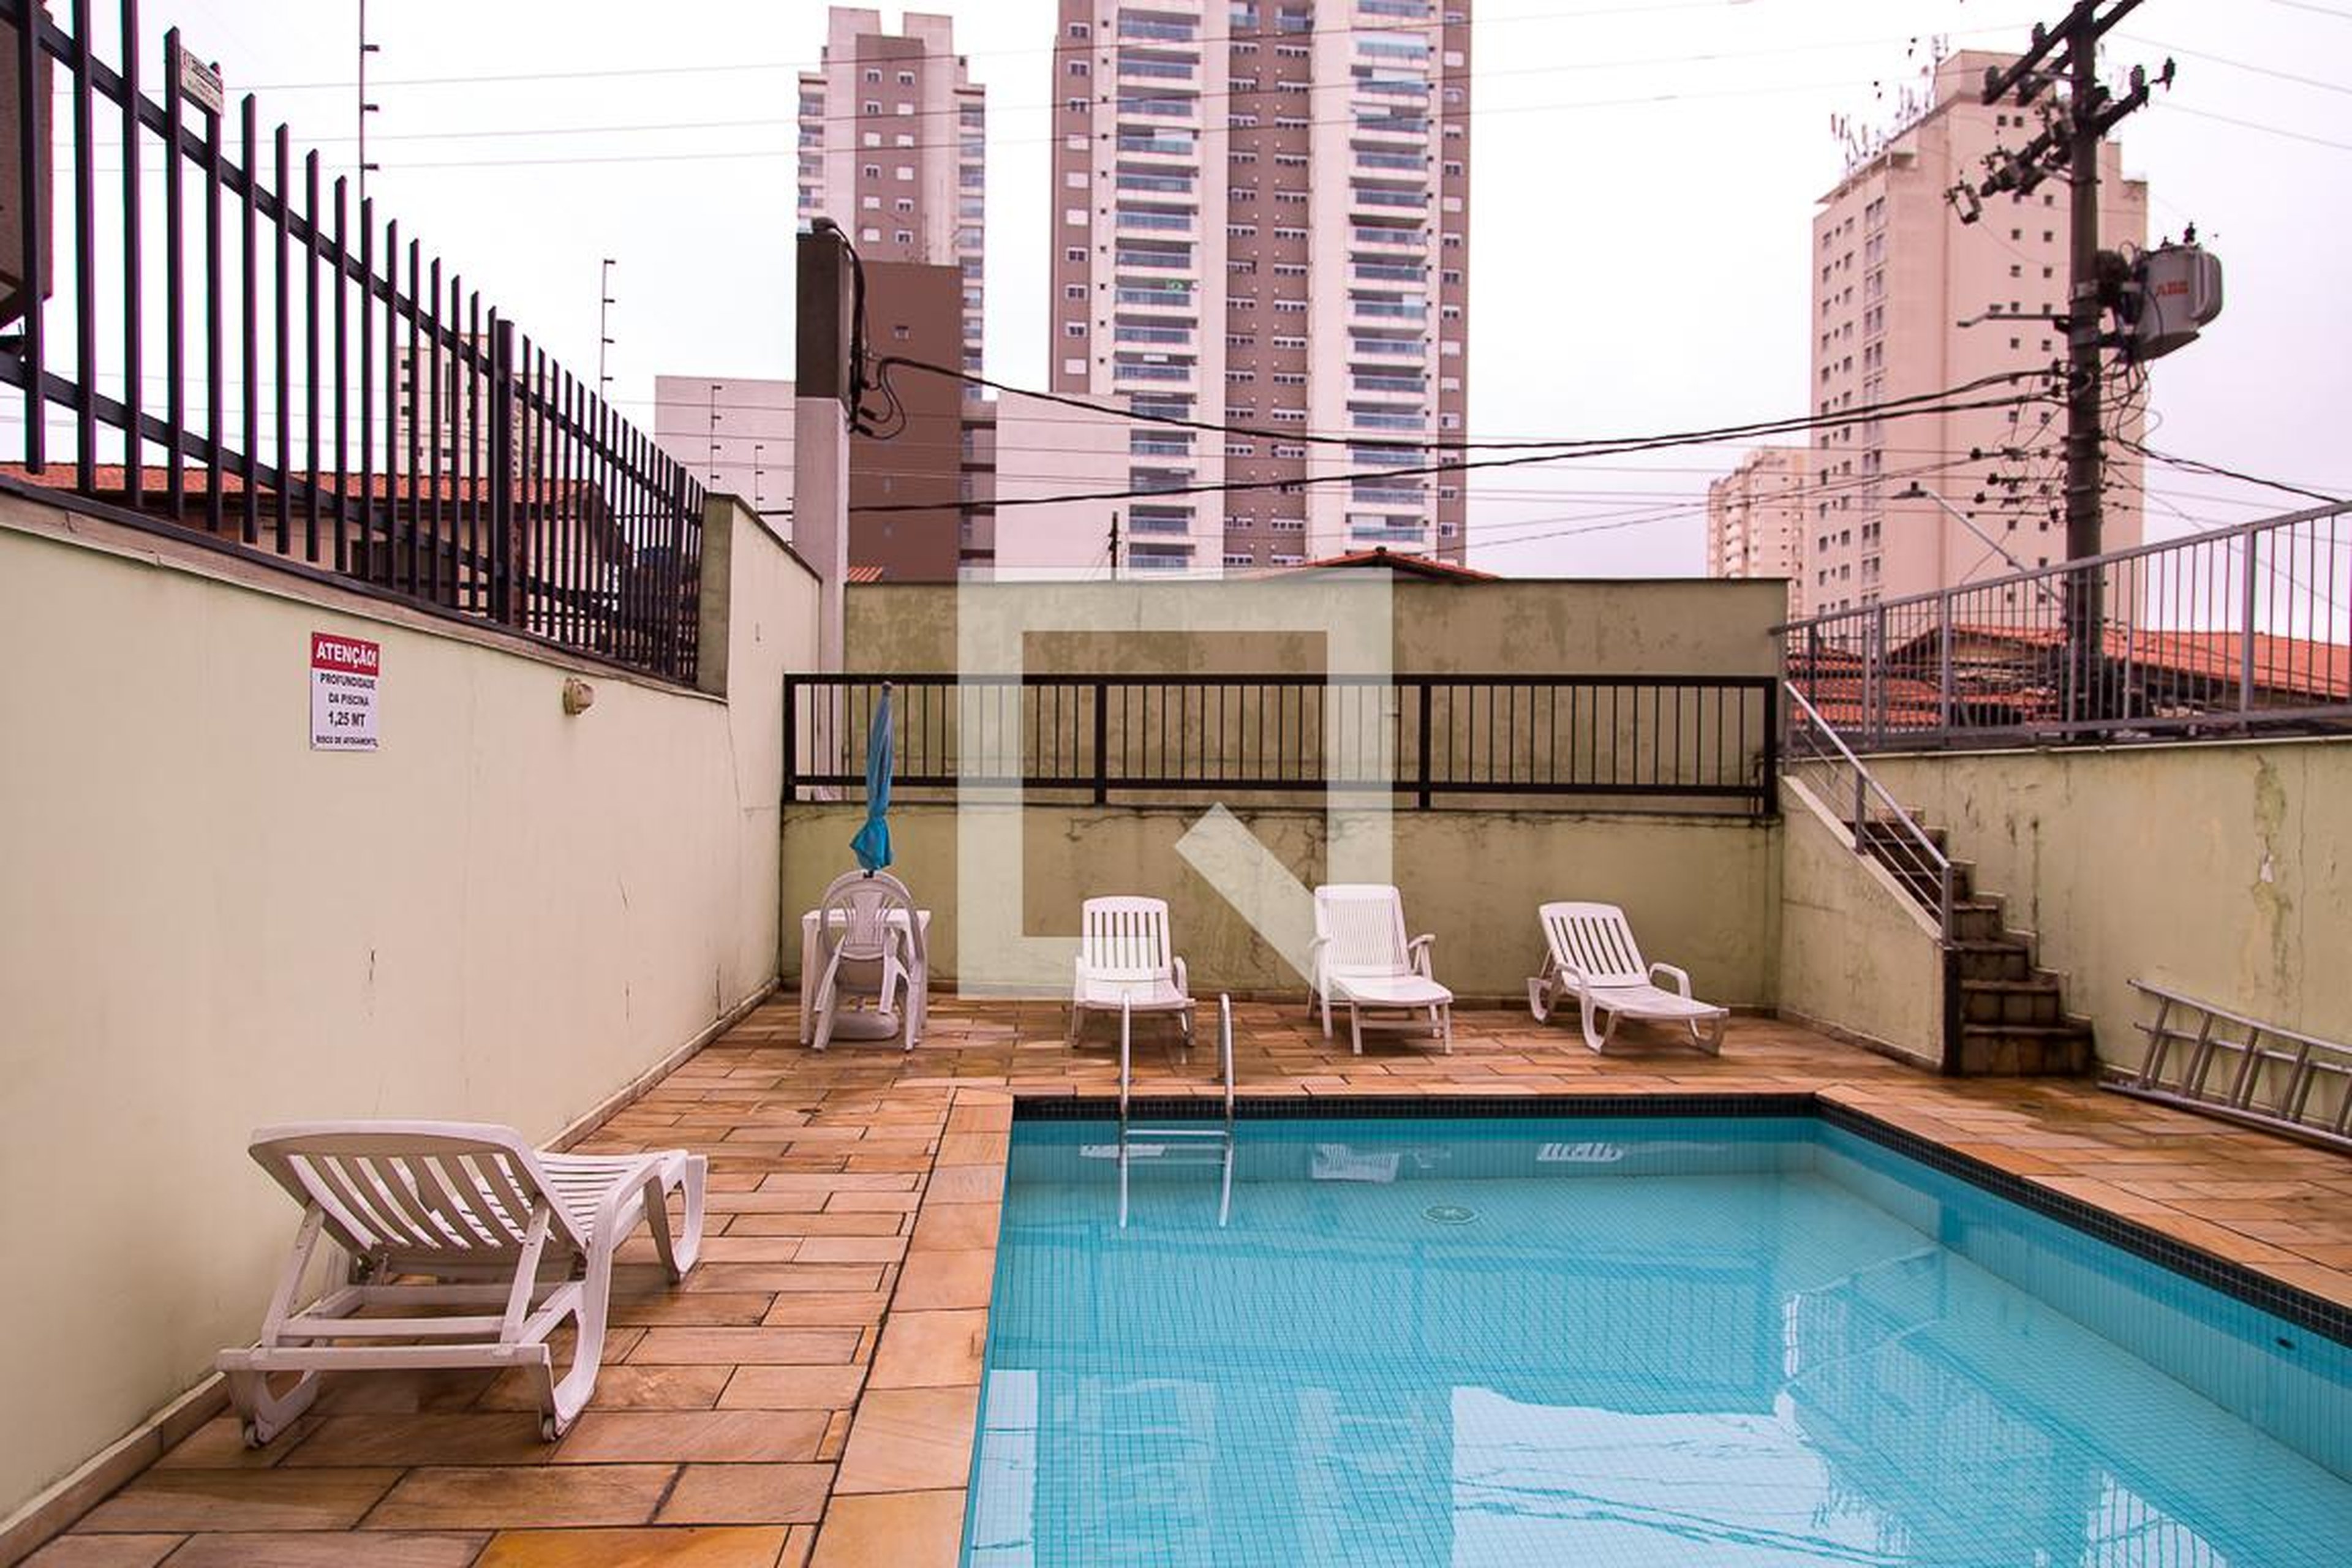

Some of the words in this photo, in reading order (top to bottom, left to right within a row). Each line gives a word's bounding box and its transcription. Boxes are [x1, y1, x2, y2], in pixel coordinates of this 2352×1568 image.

[316, 641, 377, 668] ATENÇÃO!
[320, 673, 375, 690] PROFUNDIDADE
[328, 692, 339, 703] DA
[341, 693, 369, 706] PISCINA
[328, 710, 350, 727] 1,25
[351, 712, 366, 727] MT
